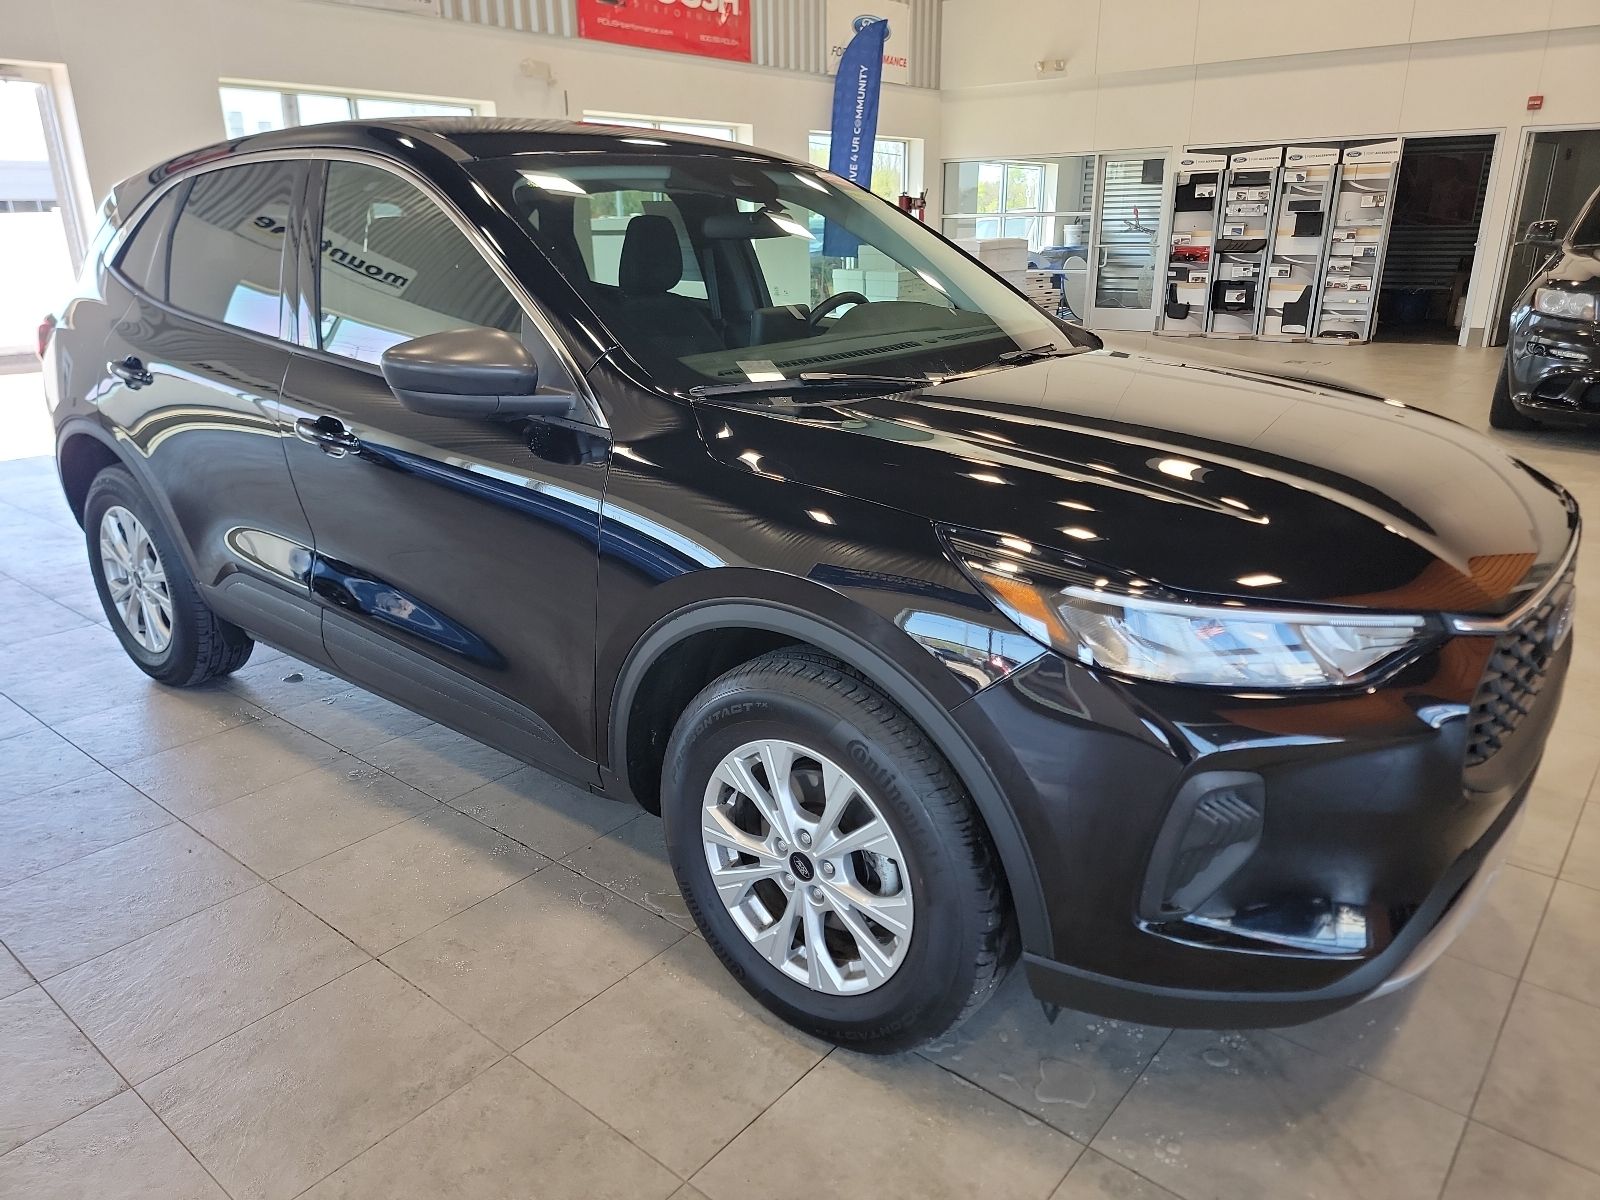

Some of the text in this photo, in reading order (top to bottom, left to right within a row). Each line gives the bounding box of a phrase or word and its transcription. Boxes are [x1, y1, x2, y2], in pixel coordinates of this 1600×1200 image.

[851, 137, 861, 153] UR
[850, 154, 859, 162] 4
[849, 164, 859, 182] IVE
